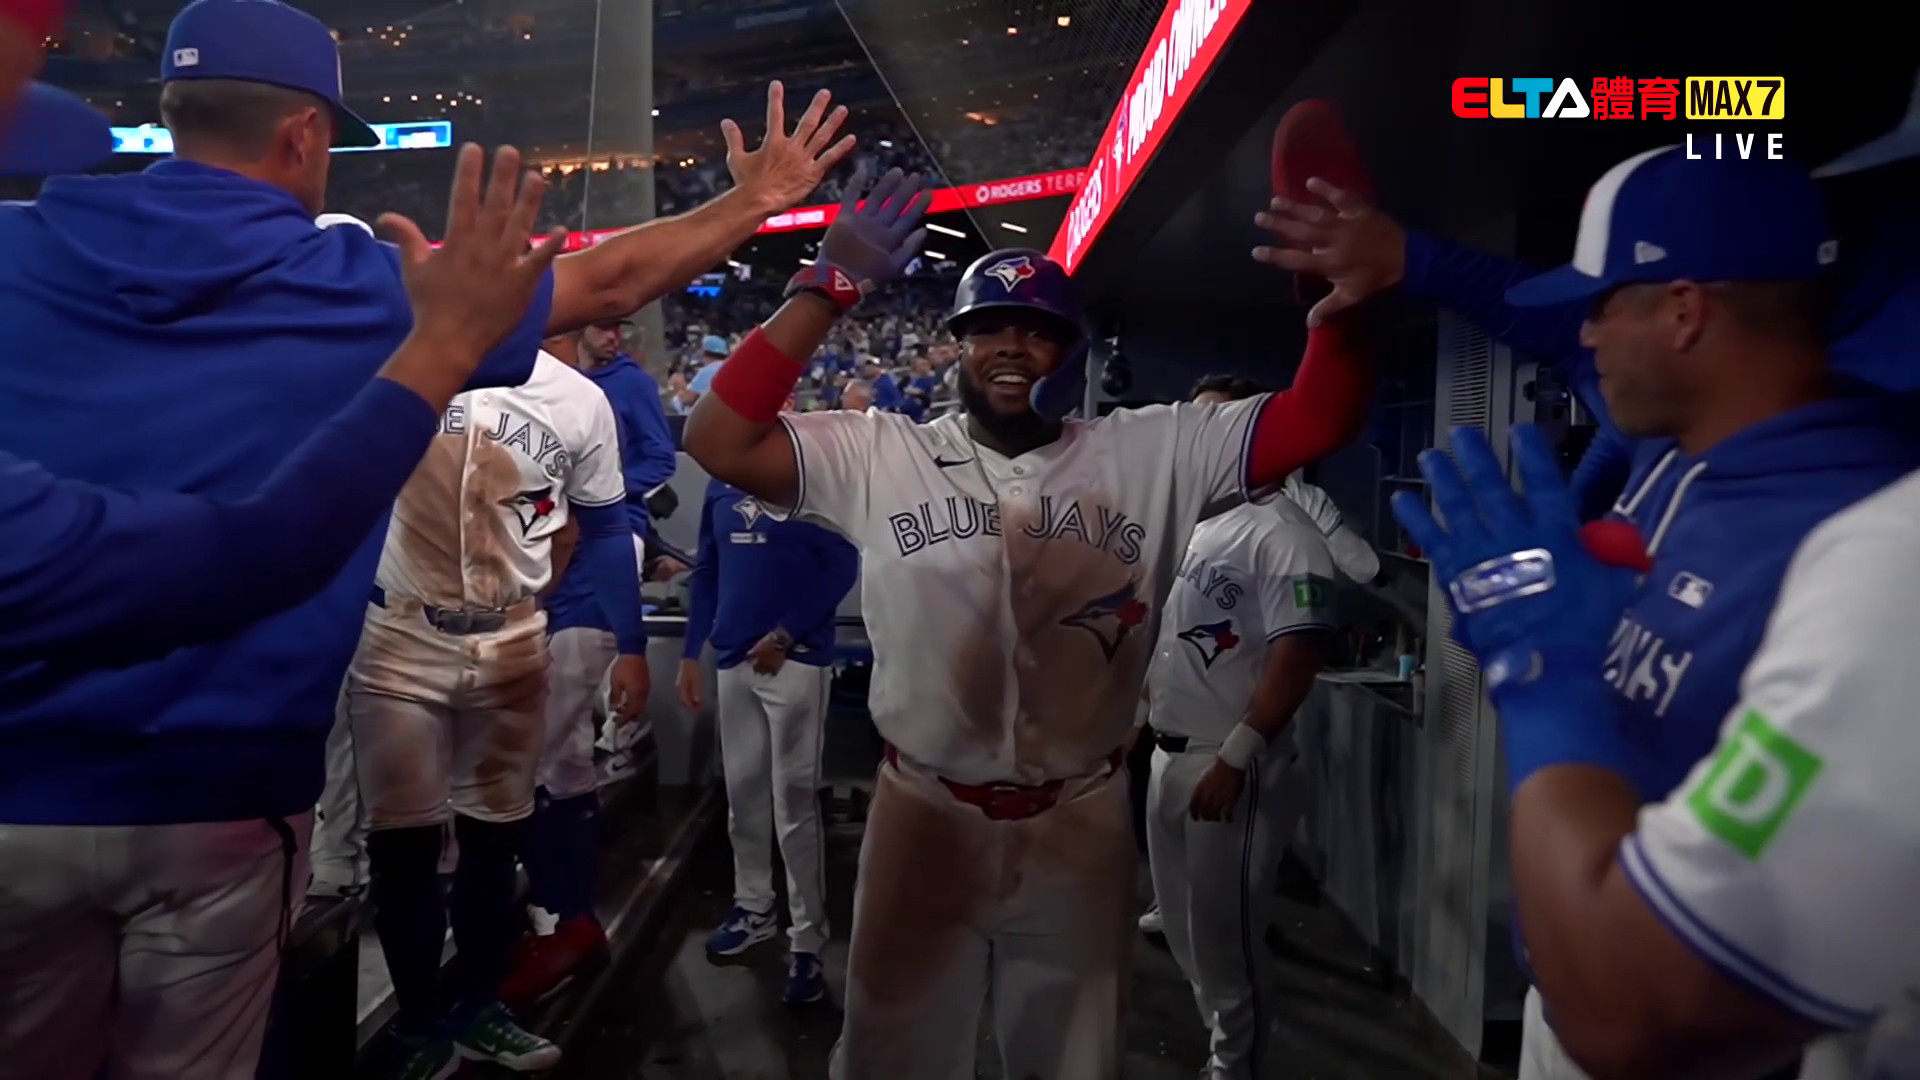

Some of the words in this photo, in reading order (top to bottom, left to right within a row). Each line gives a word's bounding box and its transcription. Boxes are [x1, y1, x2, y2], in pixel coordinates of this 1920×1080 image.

[1127, 38, 1167, 164] PROUD
[990, 178, 1042, 199] ROGERS
[484, 411, 569, 477] JAYS
[888, 496, 1002, 557] BLUE
[1023, 496, 1147, 564] JAYS
